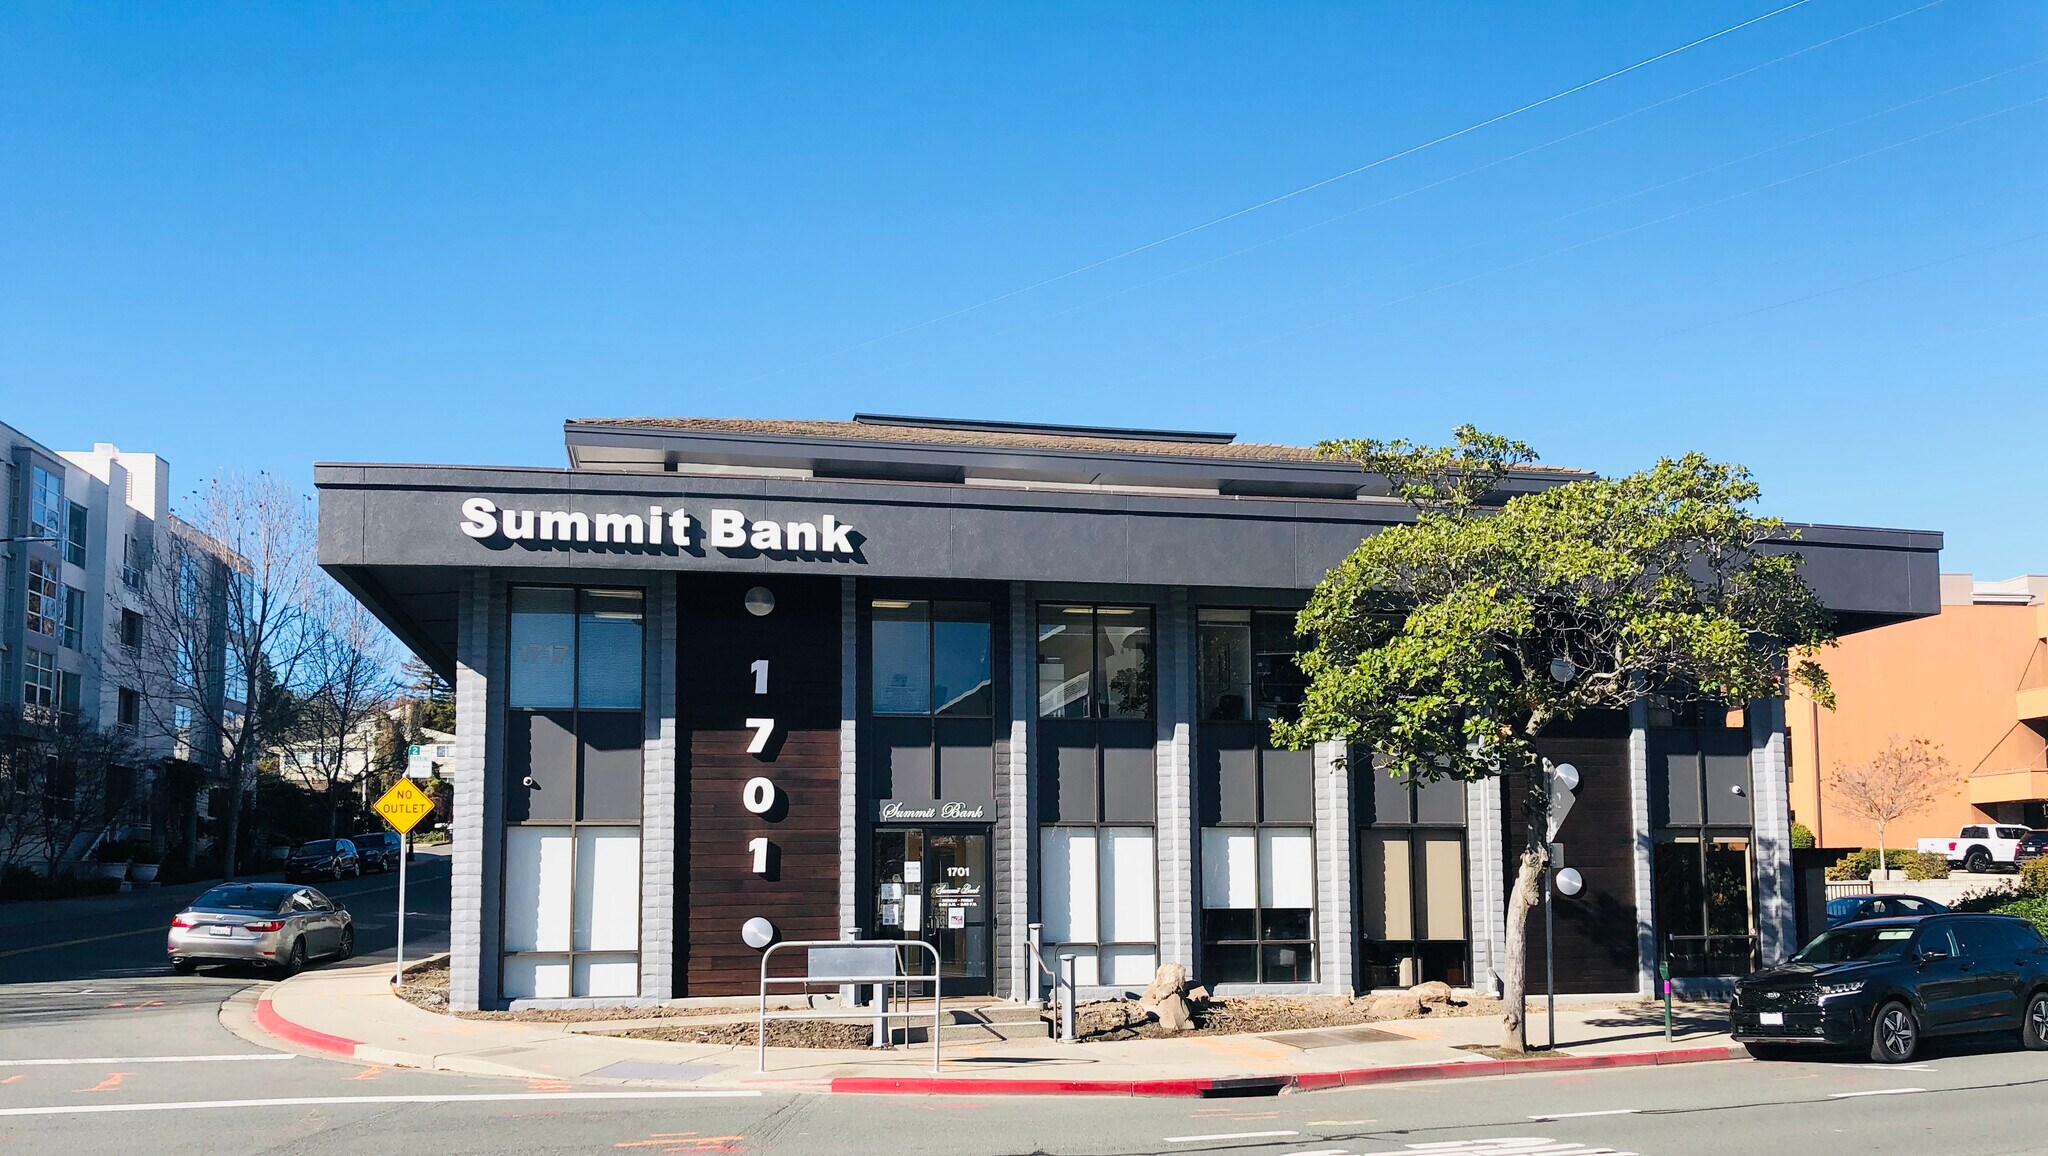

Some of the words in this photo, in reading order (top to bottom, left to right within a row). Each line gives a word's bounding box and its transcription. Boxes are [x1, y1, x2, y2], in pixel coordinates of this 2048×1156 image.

[459, 498, 691, 547] Summit
[710, 508, 854, 554] Bank
[397, 790, 412, 799] NO
[383, 804, 425, 813] OUTLET
[882, 801, 937, 821] Summit
[941, 801, 984, 818] Bank
[946, 867, 970, 877] 1701
